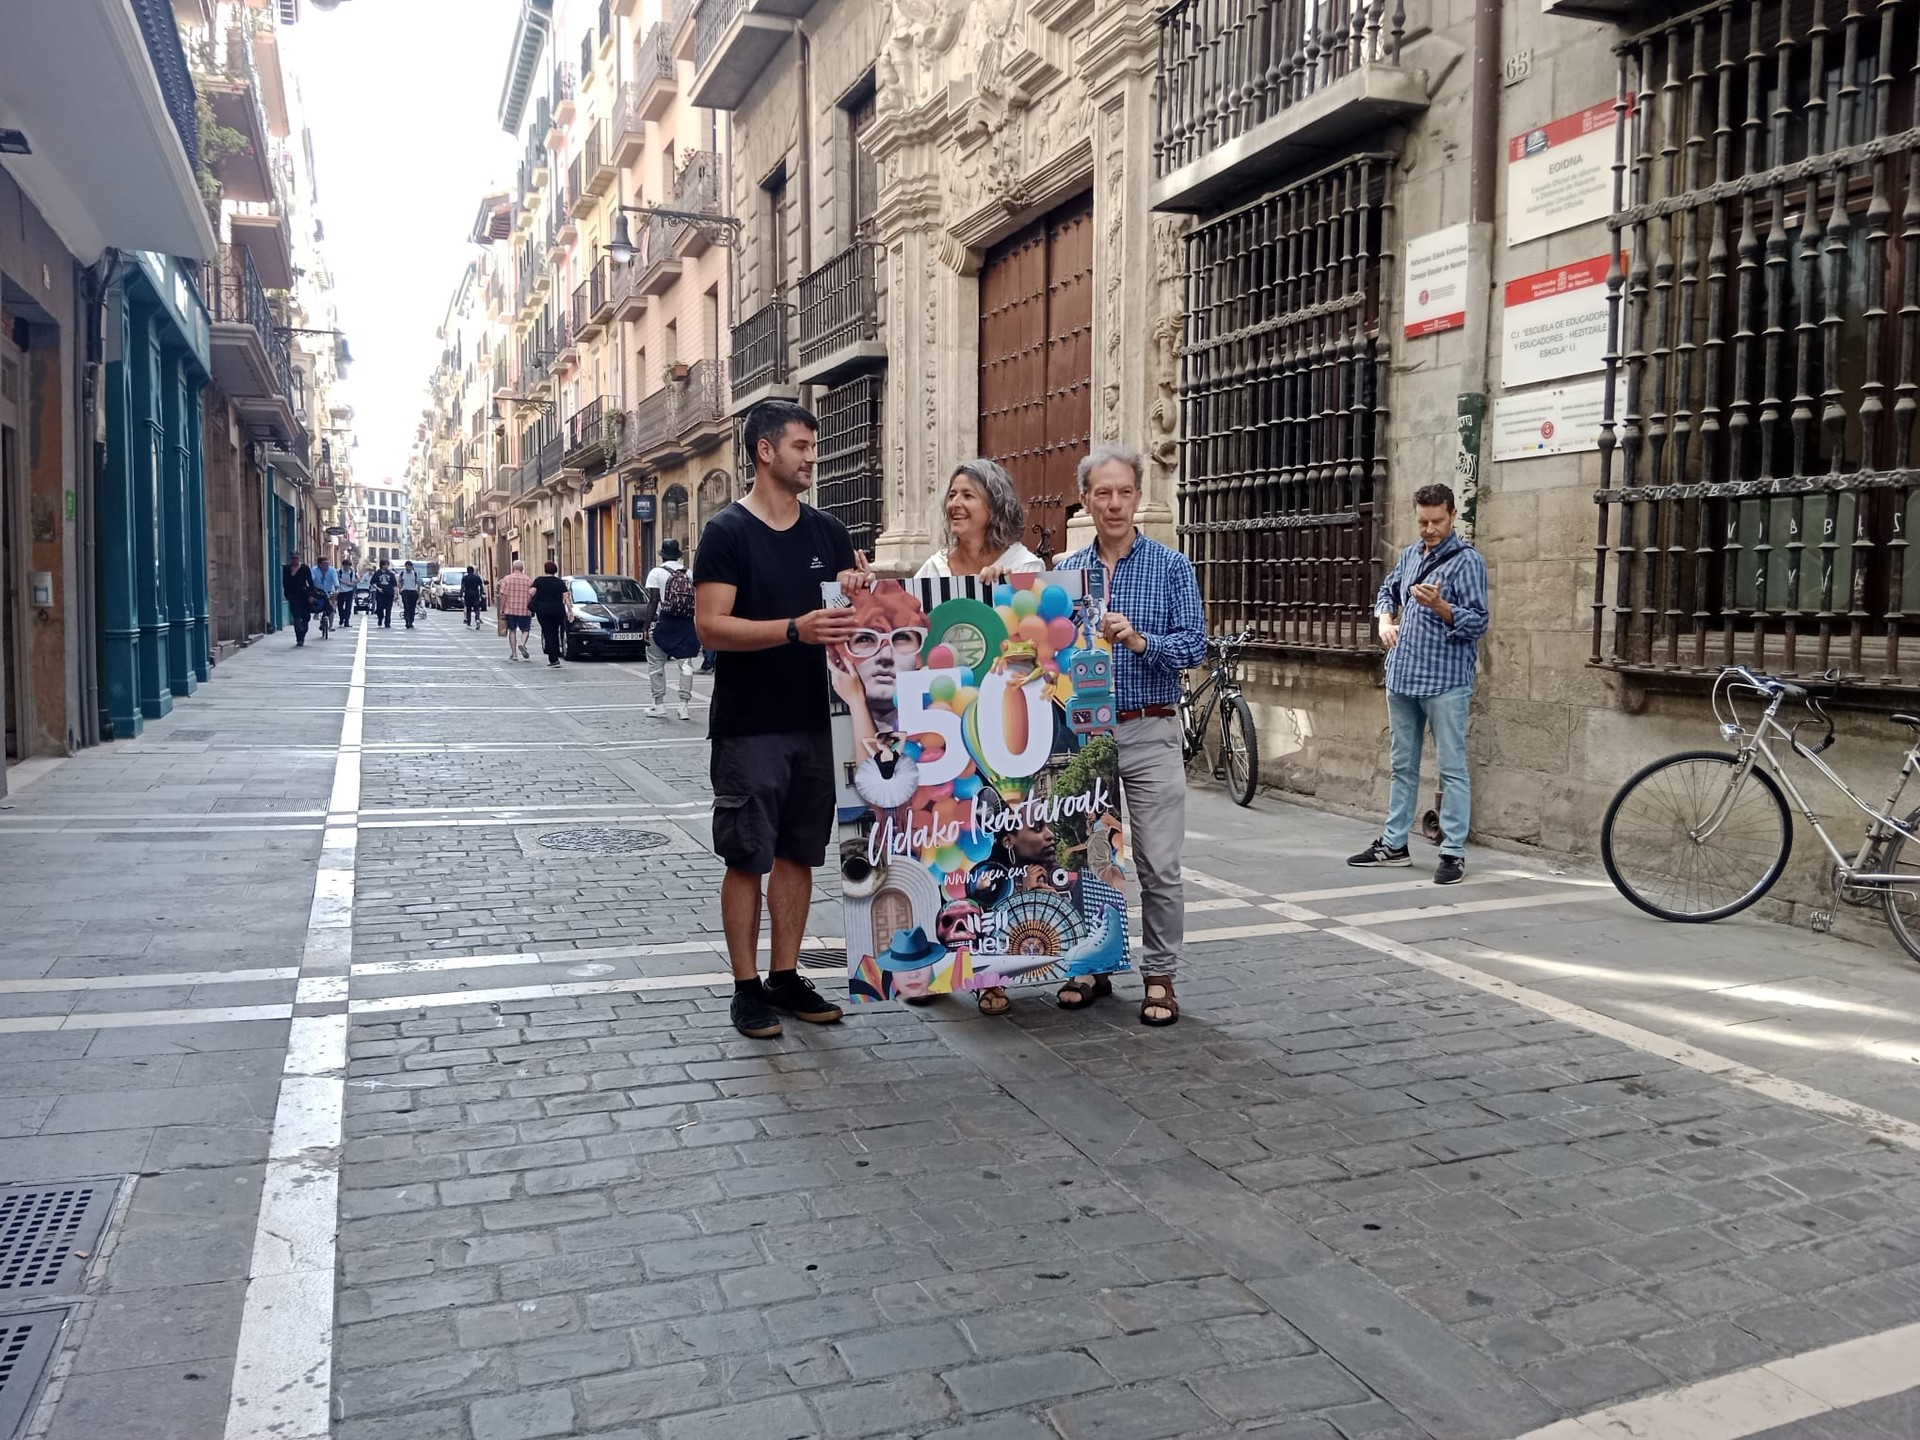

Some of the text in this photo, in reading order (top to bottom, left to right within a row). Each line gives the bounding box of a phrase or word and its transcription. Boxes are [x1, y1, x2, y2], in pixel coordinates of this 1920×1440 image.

[1506, 52, 1528, 80] 65
[1549, 154, 1584, 175] EOIDNA
[1555, 320, 1565, 329] DE
[1565, 310, 1610, 326] EDUCADORA
[1513, 343, 1519, 351] Y
[1519, 333, 1563, 350] EDUCADORES
[1569, 323, 1607, 339] HEZITZAILE
[896, 666, 1054, 787] 50
[868, 776, 1113, 867] Udako Ikastaroak
[944, 864, 1029, 887] wwwueu.eus
